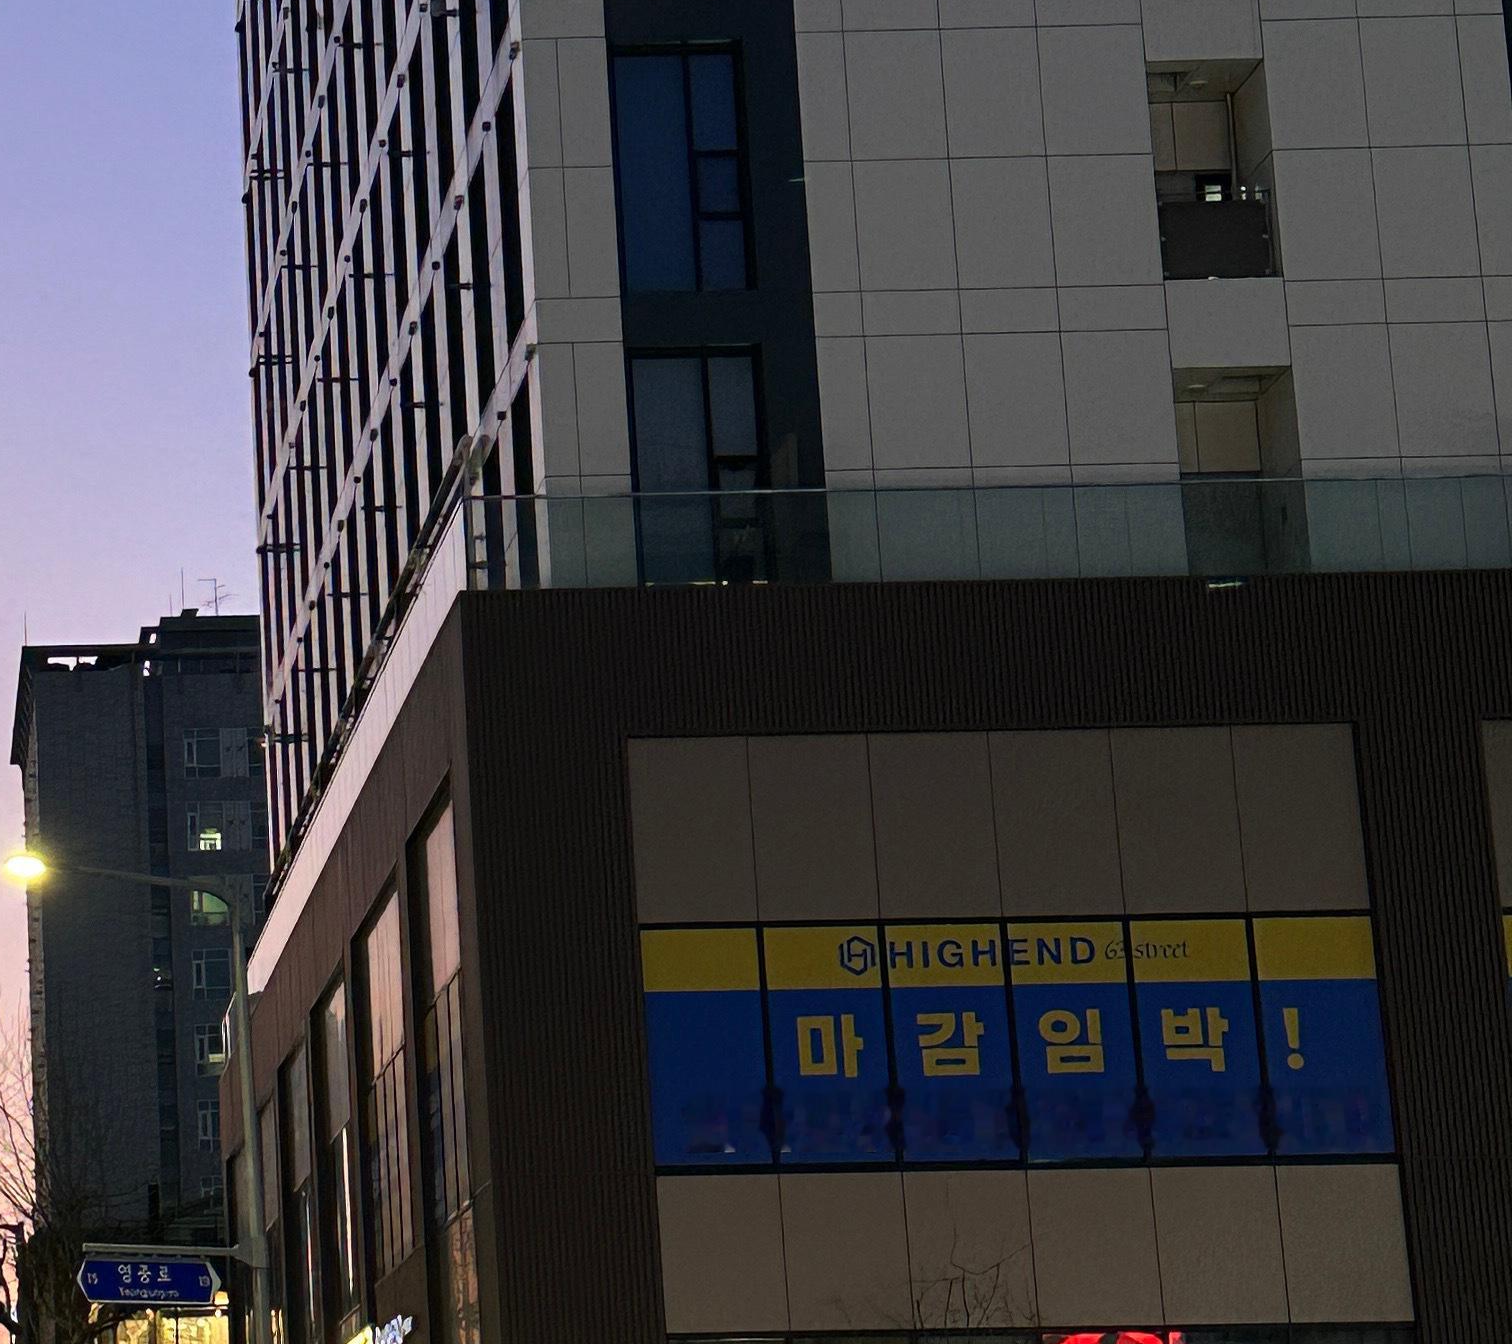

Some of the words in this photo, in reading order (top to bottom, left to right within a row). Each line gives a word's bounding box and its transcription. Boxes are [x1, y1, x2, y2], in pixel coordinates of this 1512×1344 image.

[890, 935, 1097, 970] HIGHEND
[1134, 939, 1189, 961] street
[796, 1006, 1306, 1079] 마감임박!
